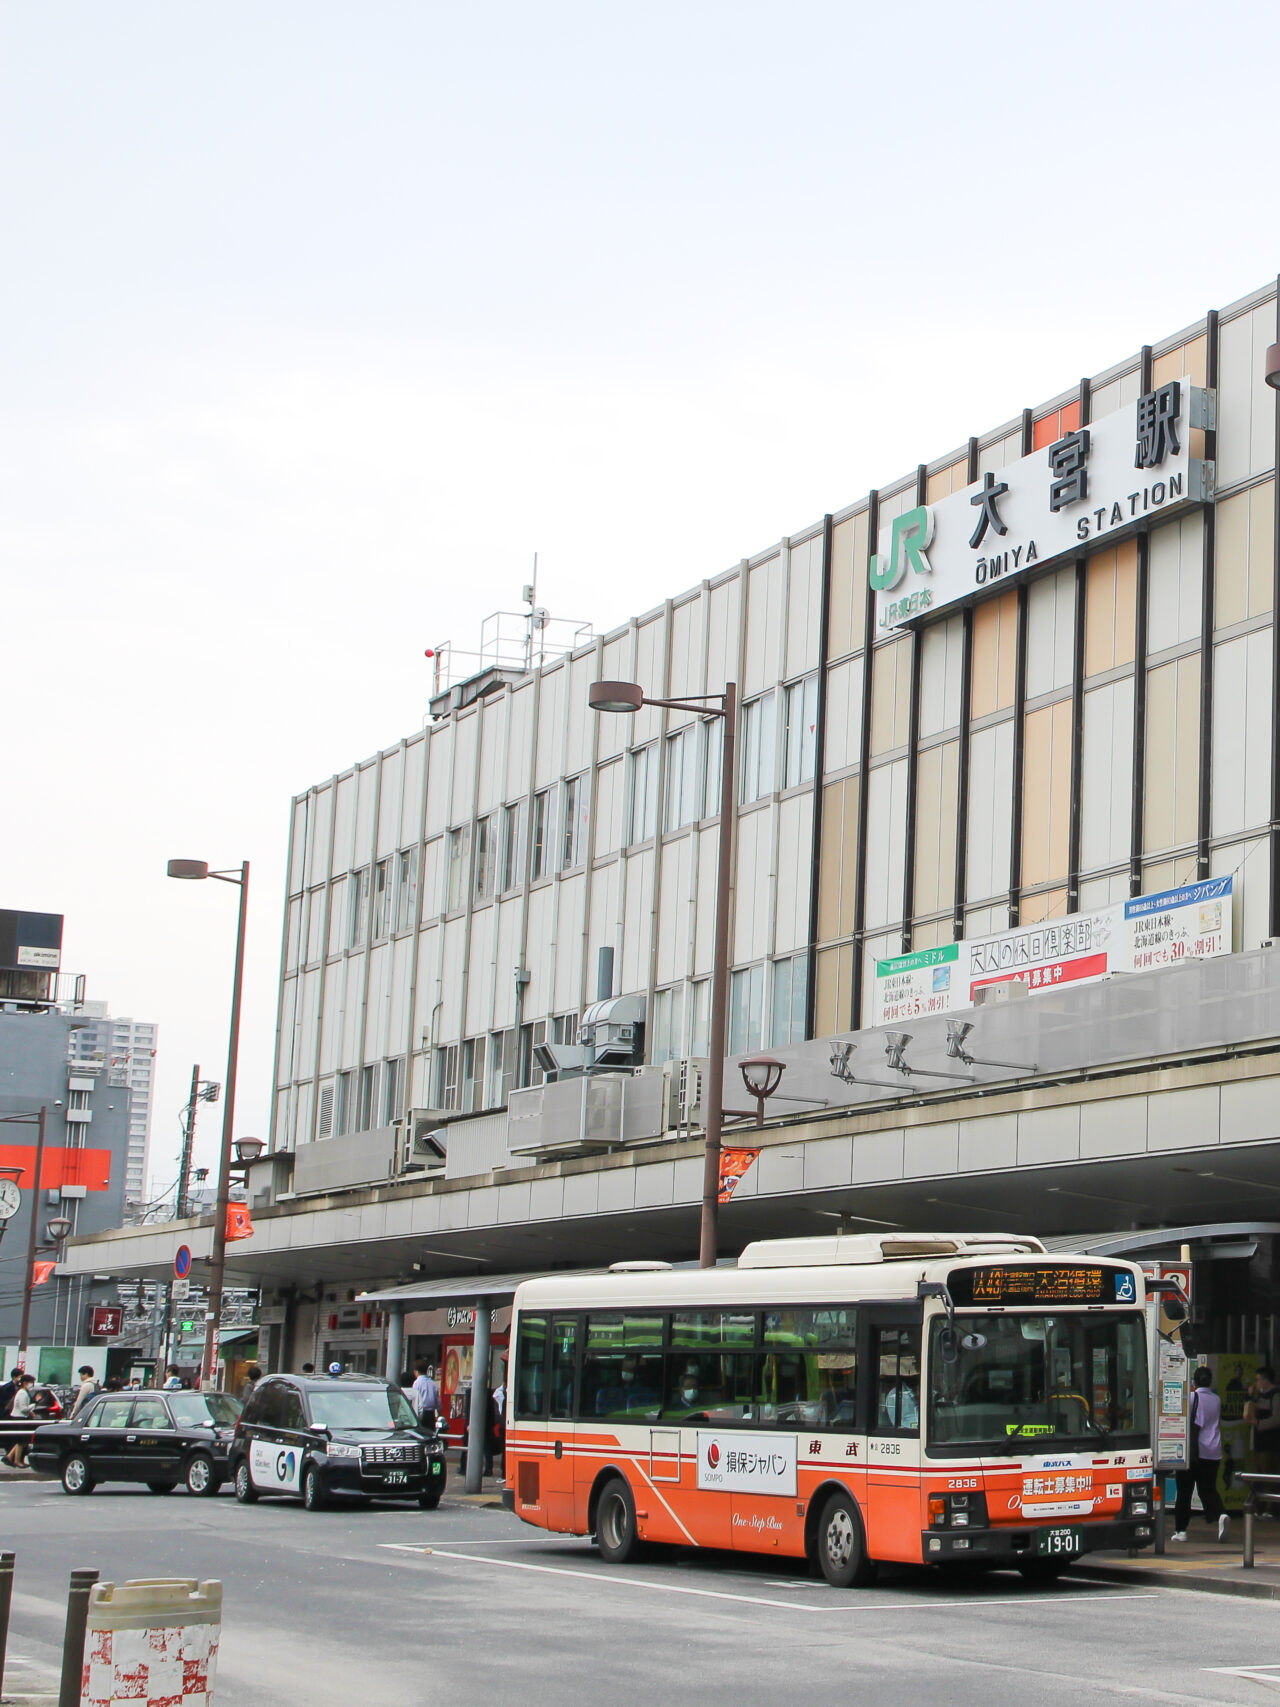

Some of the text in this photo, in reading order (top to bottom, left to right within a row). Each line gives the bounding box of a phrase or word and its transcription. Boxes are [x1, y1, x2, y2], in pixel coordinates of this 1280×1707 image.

[969, 381, 1181, 549] 大宮駅
[1076, 473, 1182, 540] STATION
[870, 505, 936, 592] JR
[878, 588, 933, 628] JR東日本
[1193, 878, 1228, 901] ジパング
[924, 950, 945, 964] ミドル
[970, 919, 1092, 975] 大人の休日倶楽部
[808, 1440, 860, 1457] 東武
[880, 1443, 901, 1455] 2836
[276, 1450, 296, 1483] GO
[726, 1451, 787, 1476] 損保ジャパン
[704, 1473, 724, 1483] SOMPO
[948, 1478, 977, 1489] 2836
[1022, 1476, 1092, 1496] 運転士募集中!!
[766, 1515, 783, 1530] Bus
